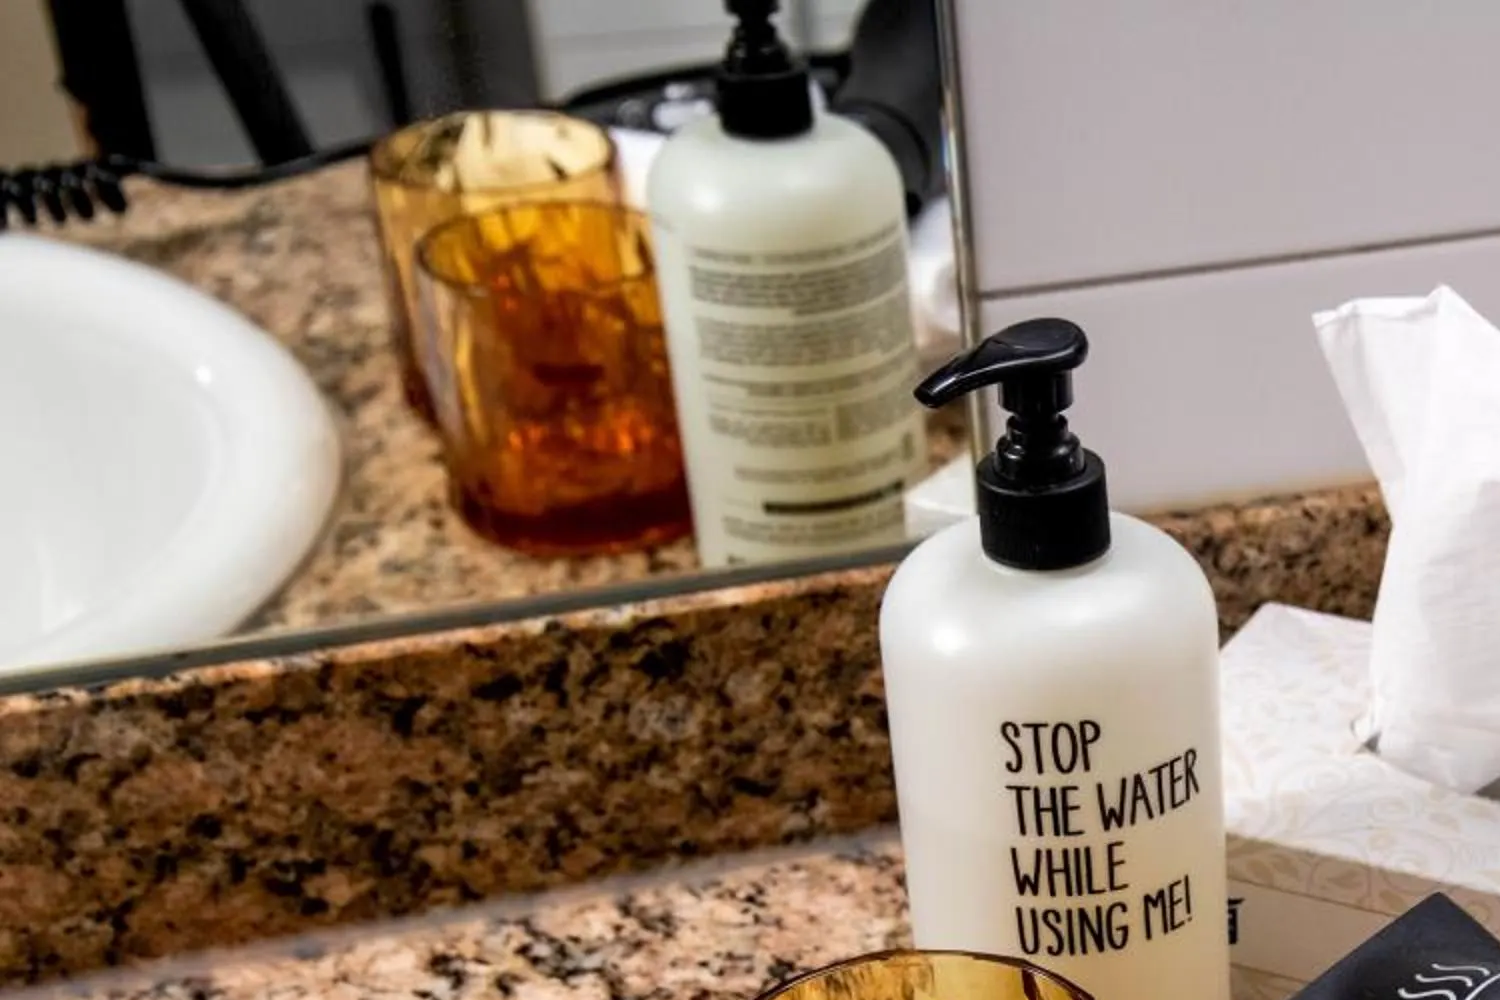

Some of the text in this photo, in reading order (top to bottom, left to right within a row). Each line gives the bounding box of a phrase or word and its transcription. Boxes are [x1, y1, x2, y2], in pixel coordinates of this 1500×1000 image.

[1001, 719, 1101, 775] STOP
[1005, 748, 1199, 836] THE WATER
[1010, 841, 1129, 897] WHILE
[1015, 901, 1129, 956] USING
[1143, 873, 1193, 941] ME!
